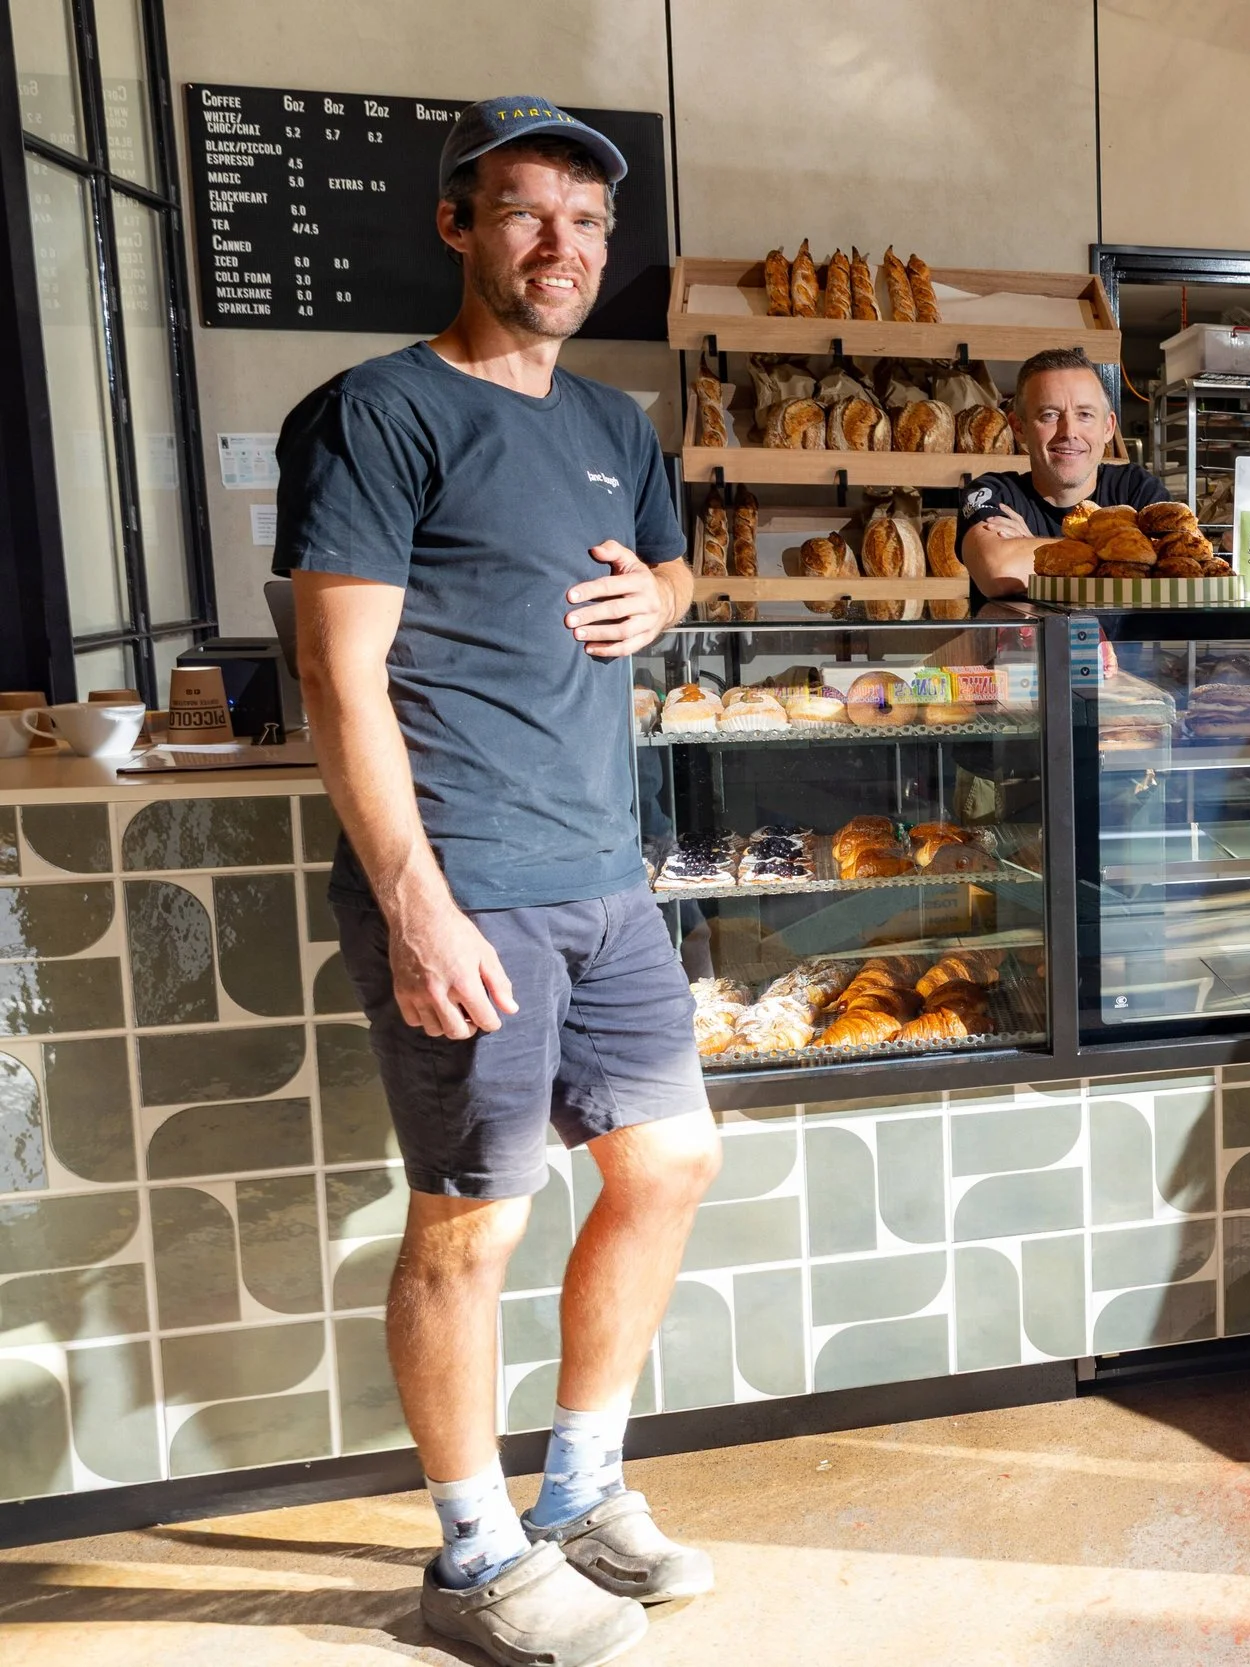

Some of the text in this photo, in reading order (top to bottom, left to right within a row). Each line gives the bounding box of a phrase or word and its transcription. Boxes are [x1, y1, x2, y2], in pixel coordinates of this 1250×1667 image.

[202, 89, 242, 109] COFFEE
[203, 111, 242, 123] WHITE/
[207, 123, 383, 144] CHOC/CHAI 5.2 5.7 6.2
[205, 140, 282, 156] BLACK/PICCOLO
[207, 155, 303, 170] ESPRESSO 4.5
[208, 172, 305, 188] MAGIC 5.0
[328, 178, 386, 192] EXTRAS 0.5
[209, 190, 268, 204] FLOCKHEART
[210, 201, 307, 216] CHAI 6.0
[211, 218, 319, 235] TEA 4/4.5
[212, 235, 252, 253] CANNED
[214, 255, 349, 270] ICED 6.0 8.0
[215, 271, 311, 286] COLD FOAM 3.0
[216, 286, 352, 303] MILKSHAKE 6.0 8.0
[218, 303, 313, 317] SPARKLING 4.0
[169, 710, 226, 727] PICCOLO
